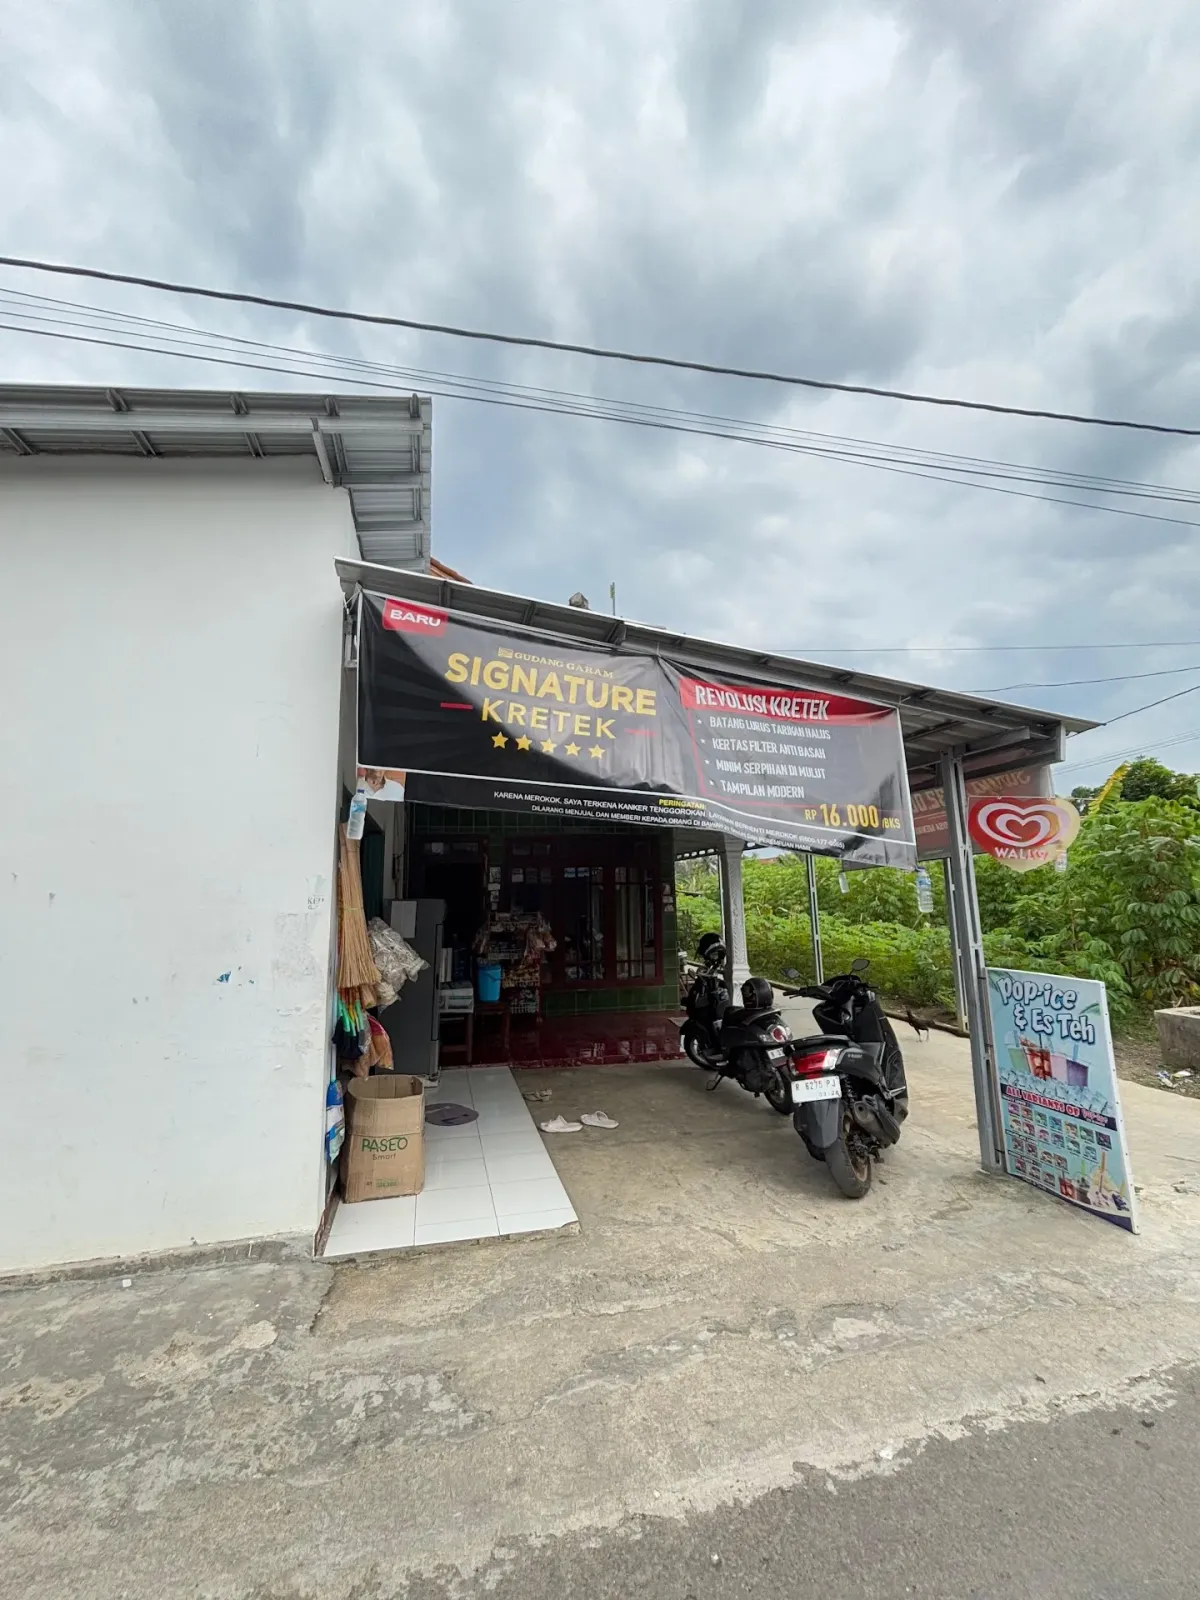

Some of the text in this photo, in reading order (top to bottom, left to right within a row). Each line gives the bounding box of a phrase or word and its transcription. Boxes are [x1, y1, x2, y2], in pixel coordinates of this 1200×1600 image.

[390, 609, 441, 627] BARU
[514, 652, 614, 678] GUDANG GARAM
[445, 653, 657, 716] SIGNATURE
[695, 685, 830, 720] REVOLUSI KRETEK
[482, 697, 616, 740] KRETEK
[709, 716, 831, 740] BATANG LURUS TARIKAN HALUS
[712, 738, 826, 759] KERTAS FILTER ANTI BASAH
[716, 759, 826, 779] MINIM SERPIHAN DI MULUT
[720, 780, 805, 798] TAMPILAN MODERN
[494, 791, 523, 801] KARENA
[563, 798, 582, 806] SAYA
[583, 799, 617, 809] TERKENA
[618, 803, 648, 812] KANKER
[766, 828, 798, 840] MEROKOK
[532, 805, 563, 814] DILARANG
[565, 808, 594, 817] MENJUAL
[611, 812, 641, 821] MEMBERI
[642, 815, 668, 824] KEPADA
[668, 818, 692, 826] ORANG
[805, 803, 901, 829] RP 16.000 /BKS
[1013, 1002, 1095, 1044] & Es Teh
[1006, 1086, 1021, 1097] ALL
[1021, 1092, 1066, 1112] VARIANTS
[1066, 1104, 1080, 1116] OF
[361, 1136, 409, 1152] PASEO
[372, 1153, 396, 1161] Smart
